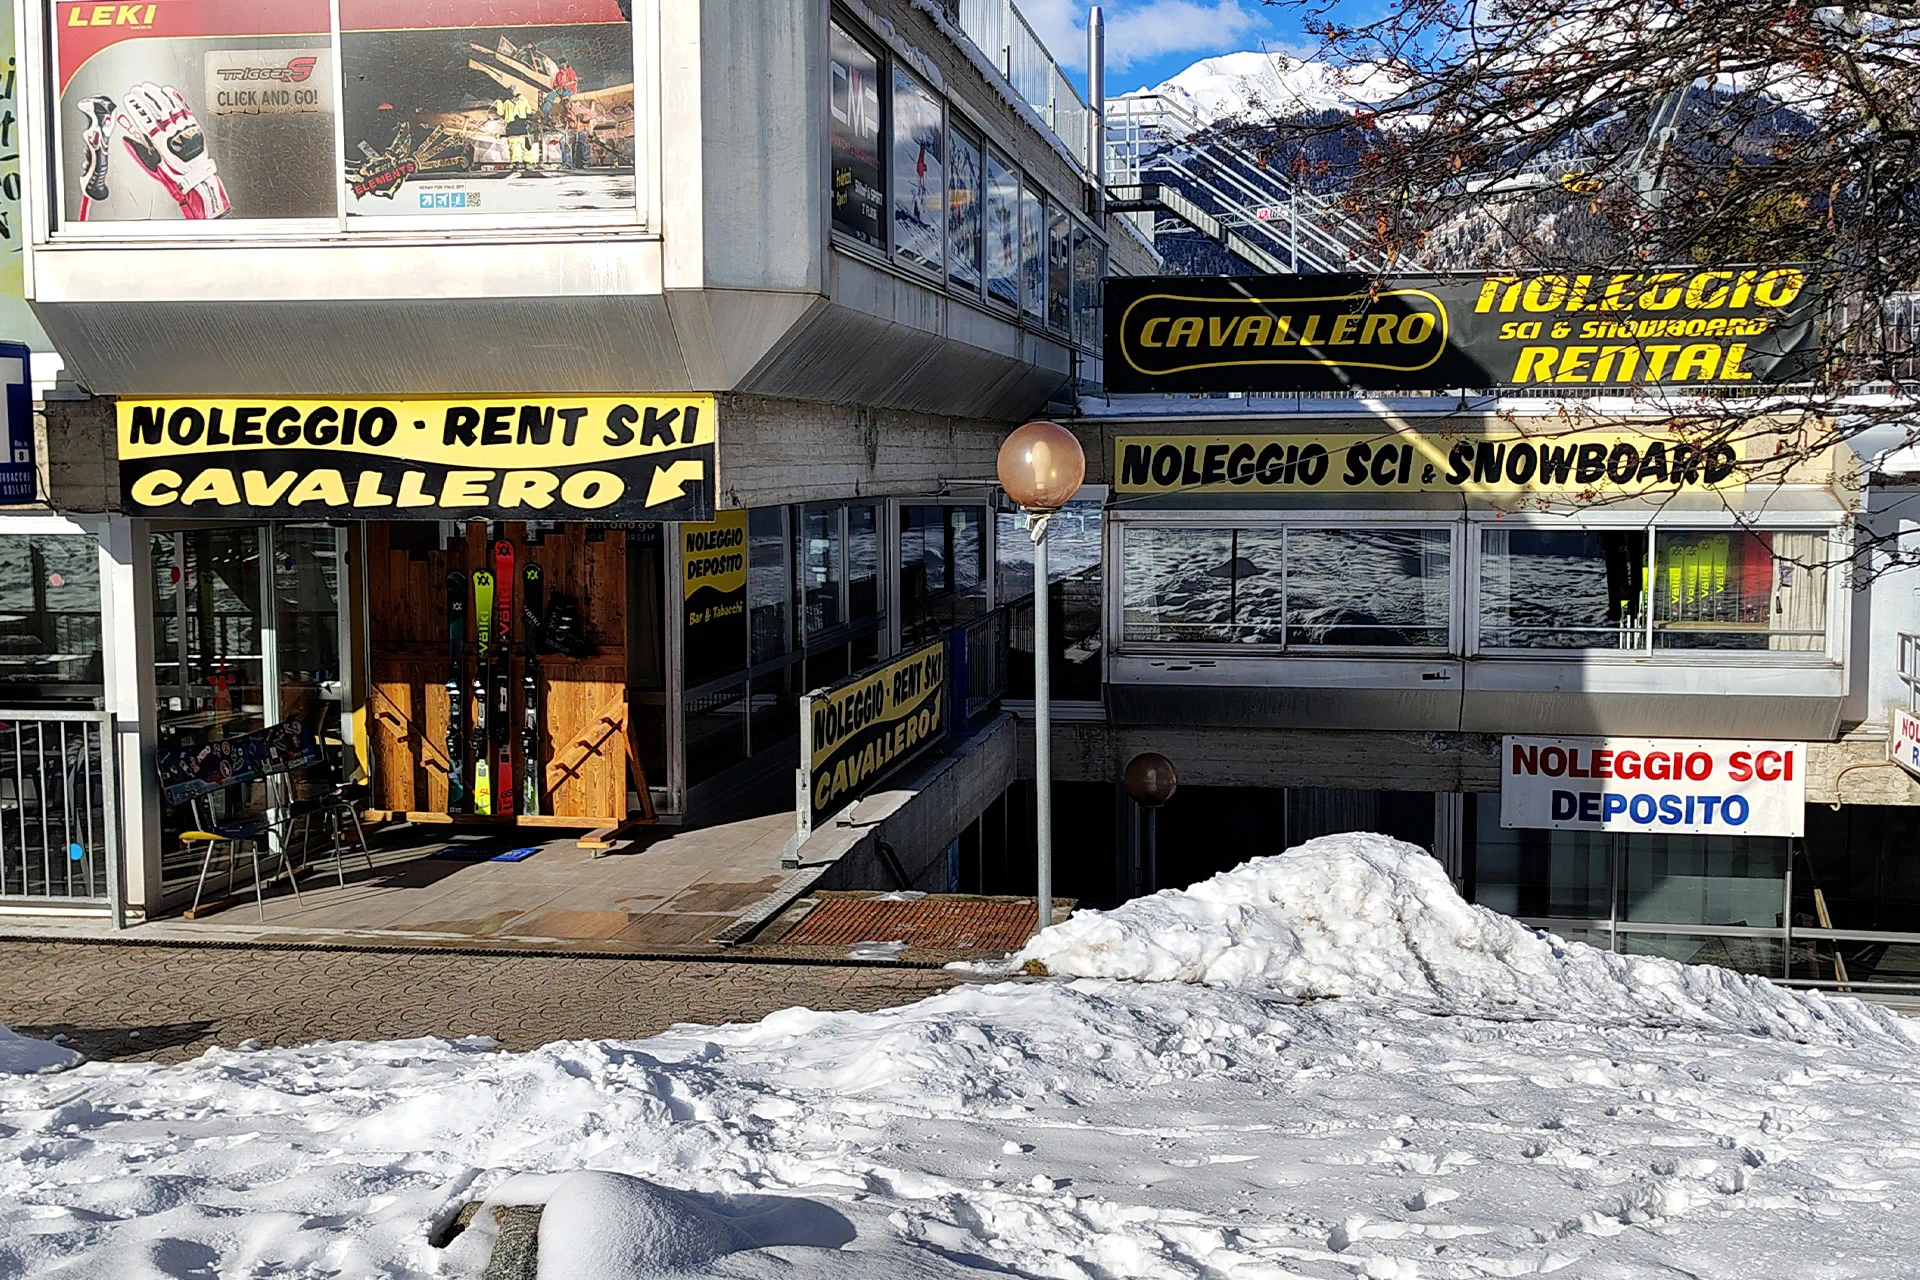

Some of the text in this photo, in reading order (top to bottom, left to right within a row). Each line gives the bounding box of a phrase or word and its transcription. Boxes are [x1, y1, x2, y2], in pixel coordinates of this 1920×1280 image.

[68, 4, 157, 27] LEKI
[217, 89, 319, 106] CLICK AND GO!
[355, 163, 416, 195] ELEMENTS
[1474, 268, 1804, 314] NOLEGGIO
[1140, 312, 1436, 348] CAVALLERO
[1498, 317, 1768, 340] SCI & SNOWBOARD
[1511, 342, 1753, 384] RENTAL
[130, 405, 397, 446] NOLEGGIO
[443, 405, 588, 447] RENT
[603, 403, 700, 447] SKI
[19, 451, 24, 461] 8
[1121, 440, 1737, 486] NOLEGGIO SCI & SNOWBOARD
[131, 467, 626, 509] CAVALLERO
[686, 527, 743, 552] NOLEGGIO
[687, 553, 743, 580] DEPOSITO
[689, 601, 744, 626] Bar & Tabacchi
[814, 679, 884, 753] NOLEGGIO
[892, 661, 923, 708] RENT
[924, 652, 942, 690] SKI
[815, 708, 930, 810] CAVALLERO
[1512, 744, 1794, 781] NOLEGGIO SCI
[1552, 790, 1749, 826] DEPOSITO
